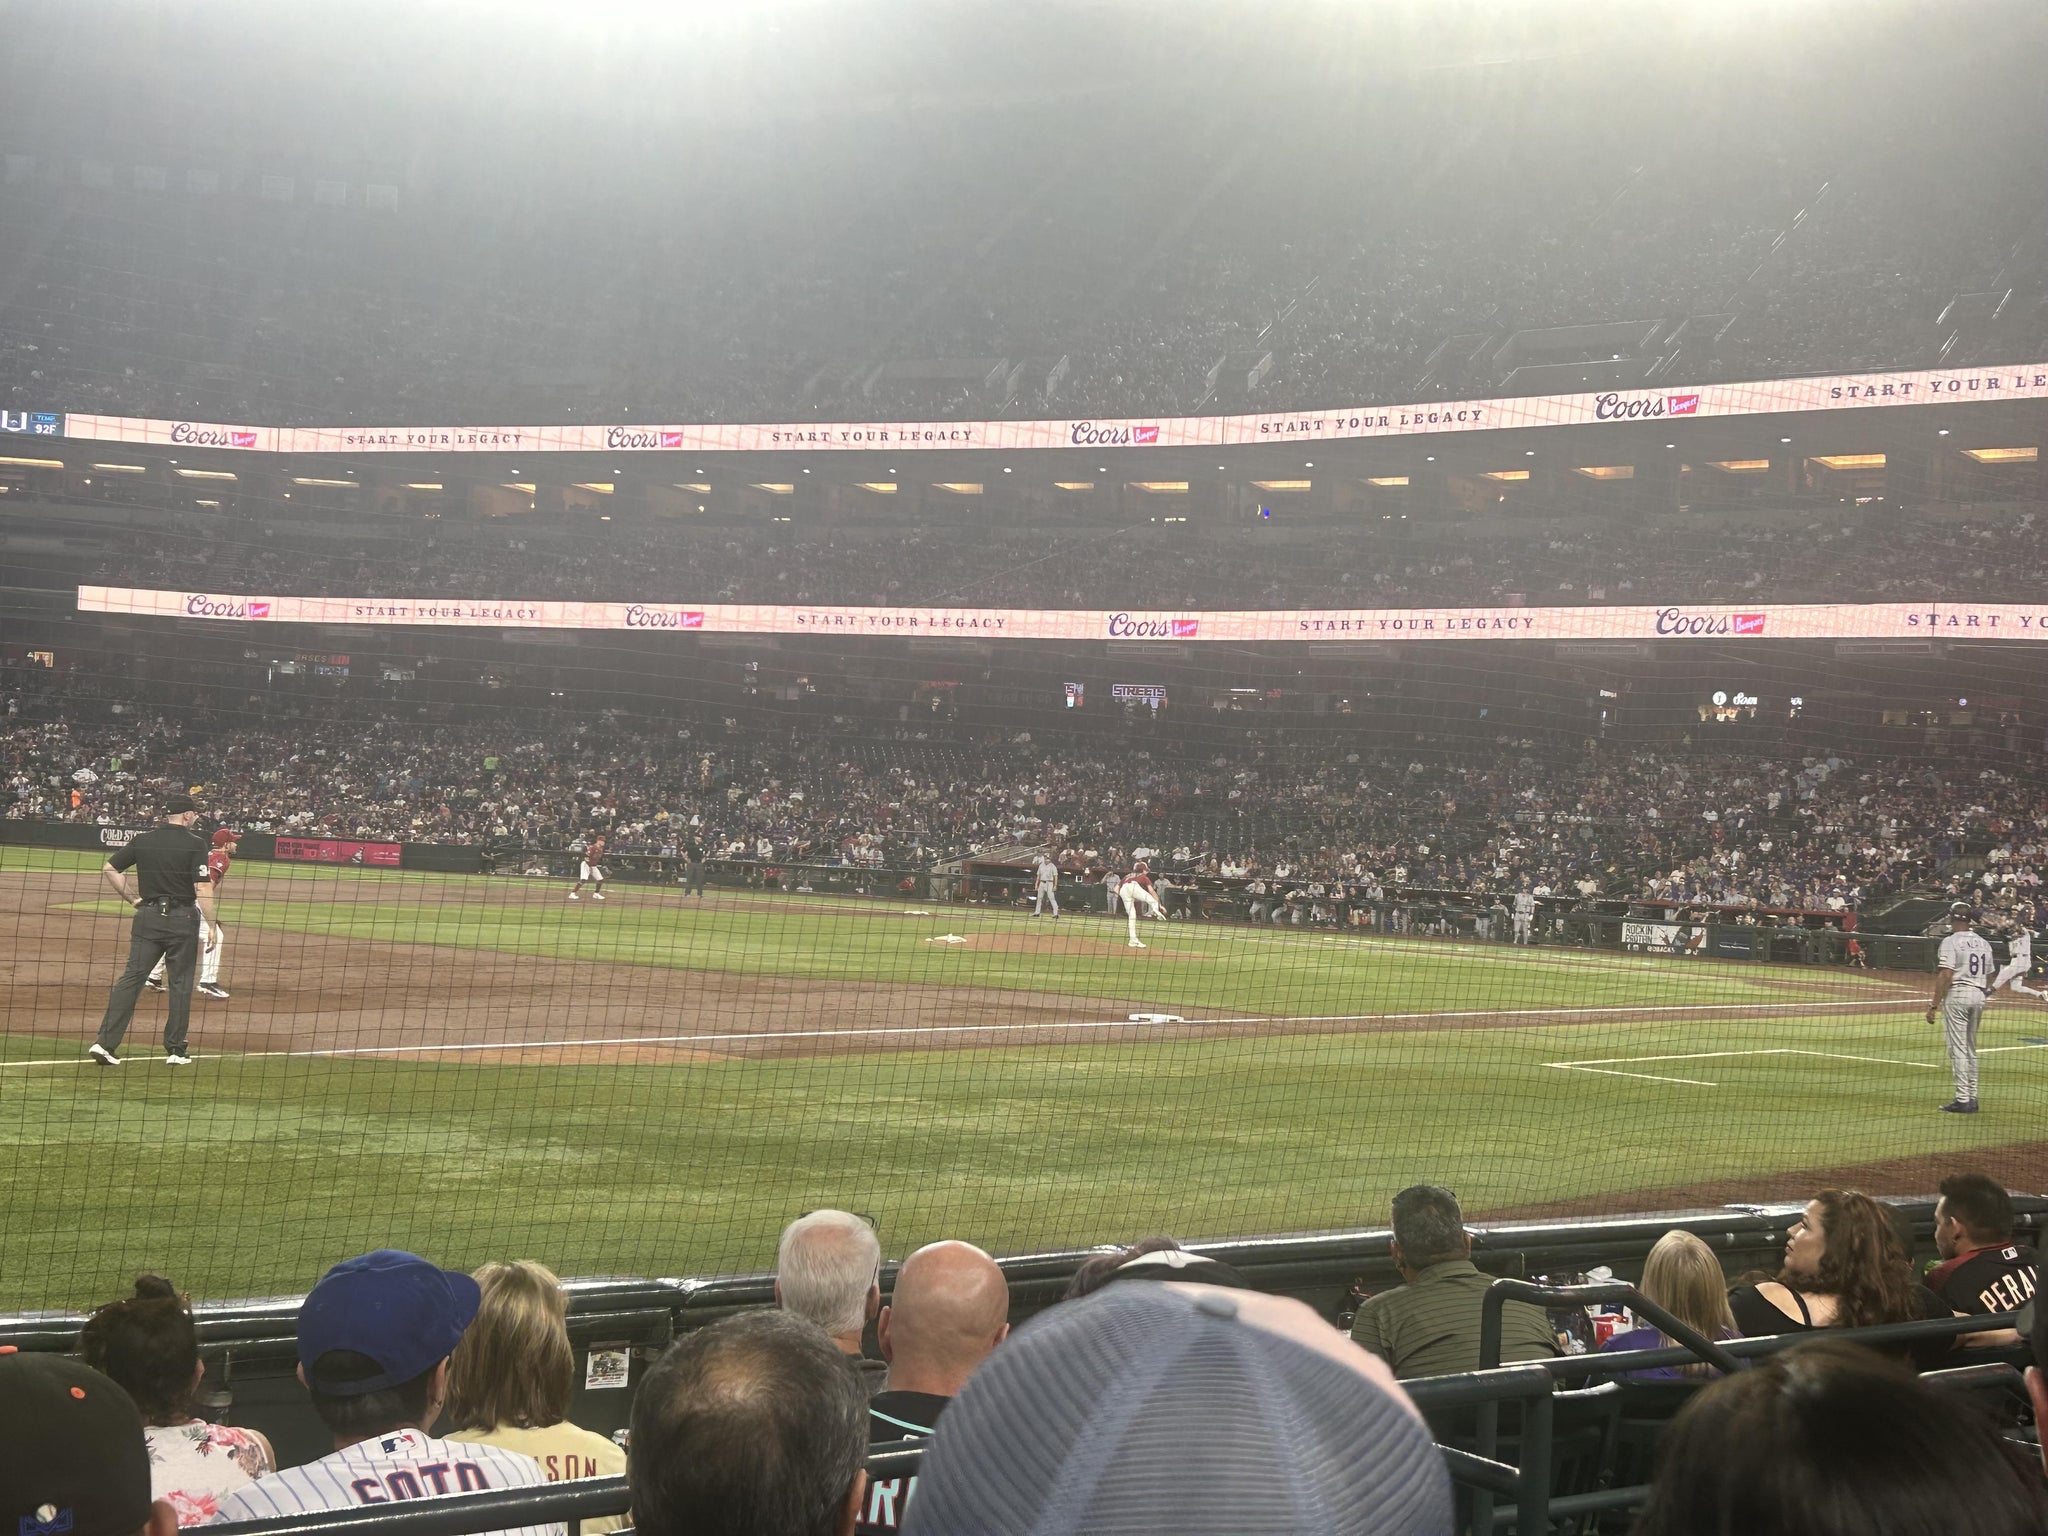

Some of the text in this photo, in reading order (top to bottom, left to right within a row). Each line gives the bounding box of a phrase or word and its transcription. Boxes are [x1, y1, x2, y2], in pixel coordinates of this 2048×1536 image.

[1830, 374, 2047, 399] START YOUR LE
[1595, 392, 1666, 420] Coors
[1671, 396, 1697, 413] Banquet
[36, 423, 57, 434] 92F
[1260, 409, 1482, 433] START YOUR LEGACY
[171, 422, 229, 446] Coors
[346, 434, 523, 445] START YOUR LEGACY
[607, 426, 658, 449] Coors
[772, 430, 972, 442] START YOUR LEGACY
[1071, 422, 1131, 445] Coors
[187, 594, 246, 617] Coors
[355, 606, 537, 619] START YOUR LEGACY
[626, 605, 678, 627] Coors
[797, 615, 1006, 629] START YOUR LEGACY
[1109, 612, 1170, 637] Coors
[1300, 618, 1534, 631] START YOUR LEGACY
[1655, 607, 1729, 634] Coors
[1736, 616, 1764, 633] Banquet
[1908, 615, 2001, 627] START
[1113, 686, 1166, 697] STREETS
[101, 828, 123, 843] COLD
[1626, 924, 1653, 936] ROCKIN
[1626, 935, 1653, 944] PROTEIN
[1969, 953, 1986, 976] 81
[534, 1455, 597, 1482] SON
[351, 1462, 491, 1504] SOTO
